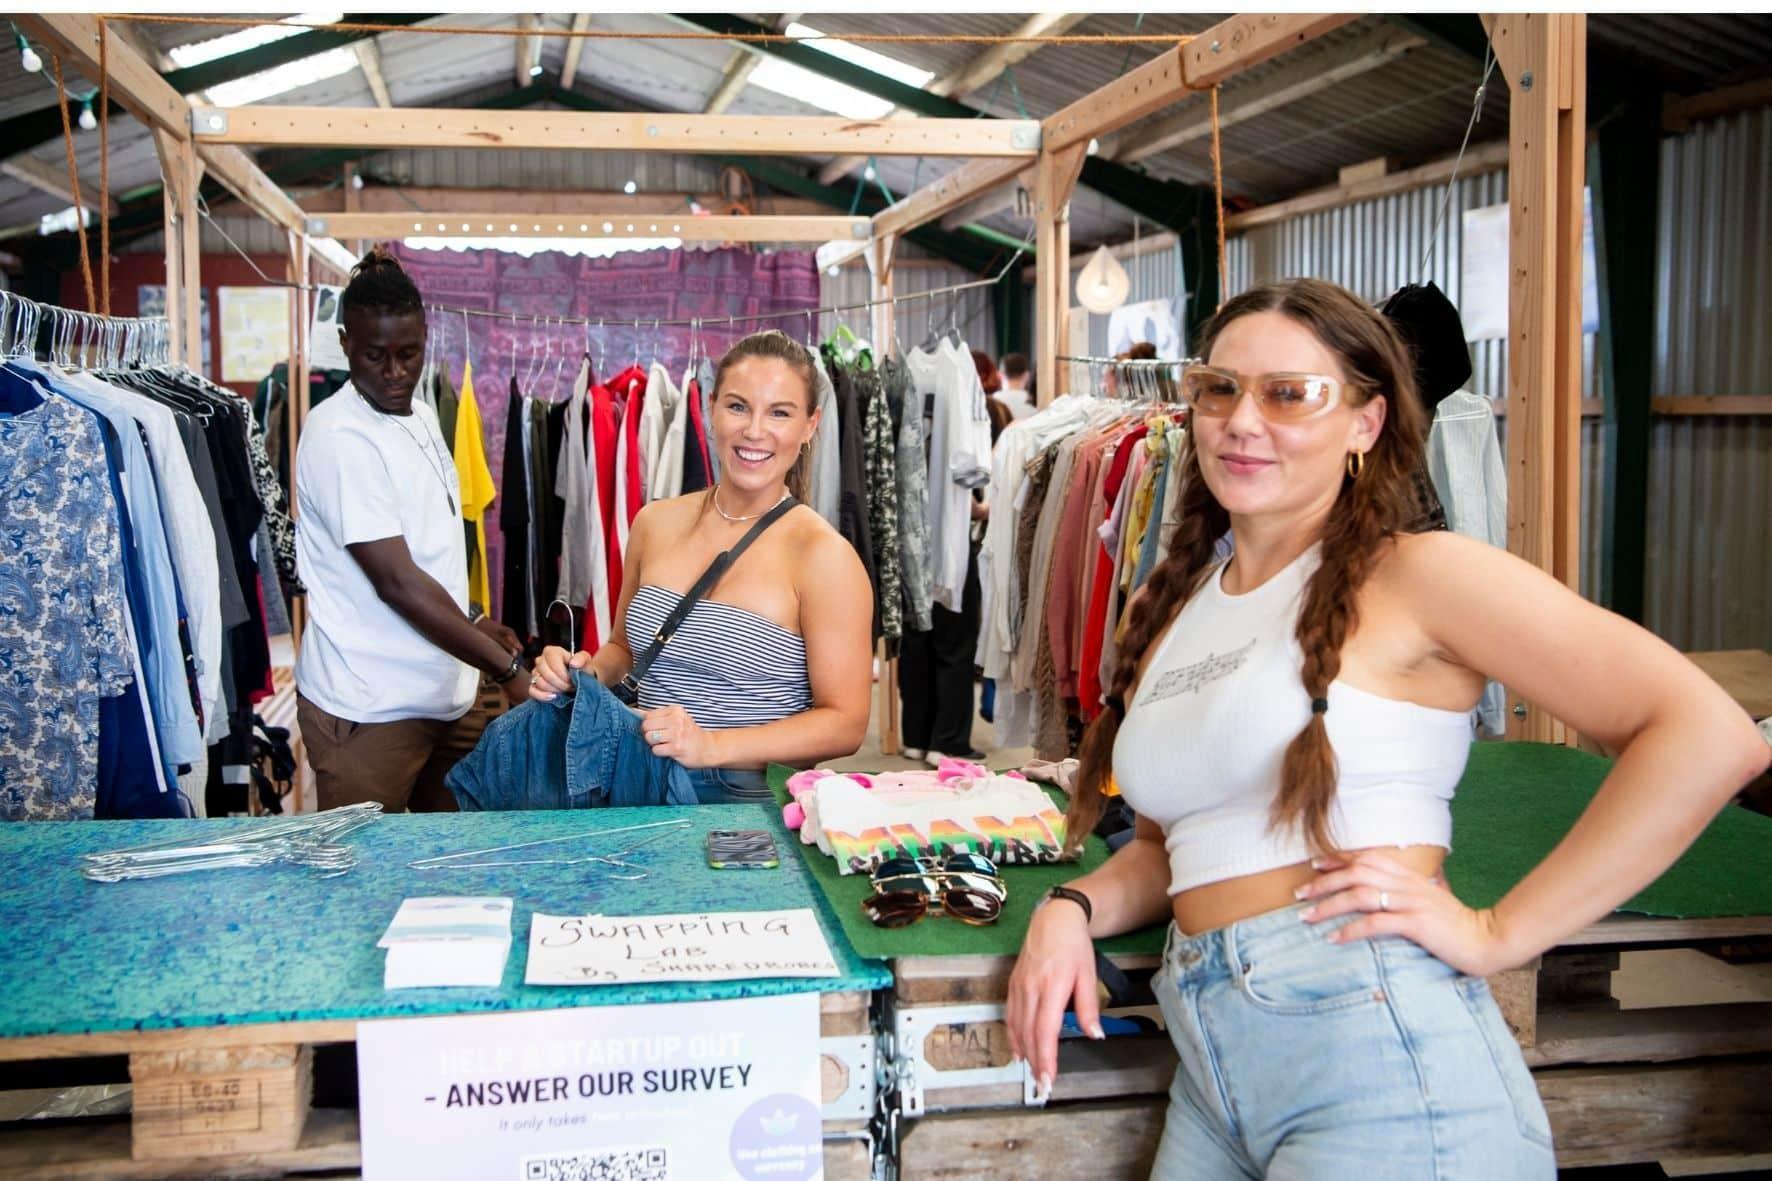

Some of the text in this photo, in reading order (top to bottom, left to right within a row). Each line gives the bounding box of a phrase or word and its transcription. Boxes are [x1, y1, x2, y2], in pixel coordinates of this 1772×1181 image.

[446, 1076, 569, 1108] ANSWER
[578, 1071, 634, 1098] OUR
[643, 1063, 752, 1093] SURVEY
[513, 1115, 544, 1132] only
[549, 1111, 587, 1128] takes
